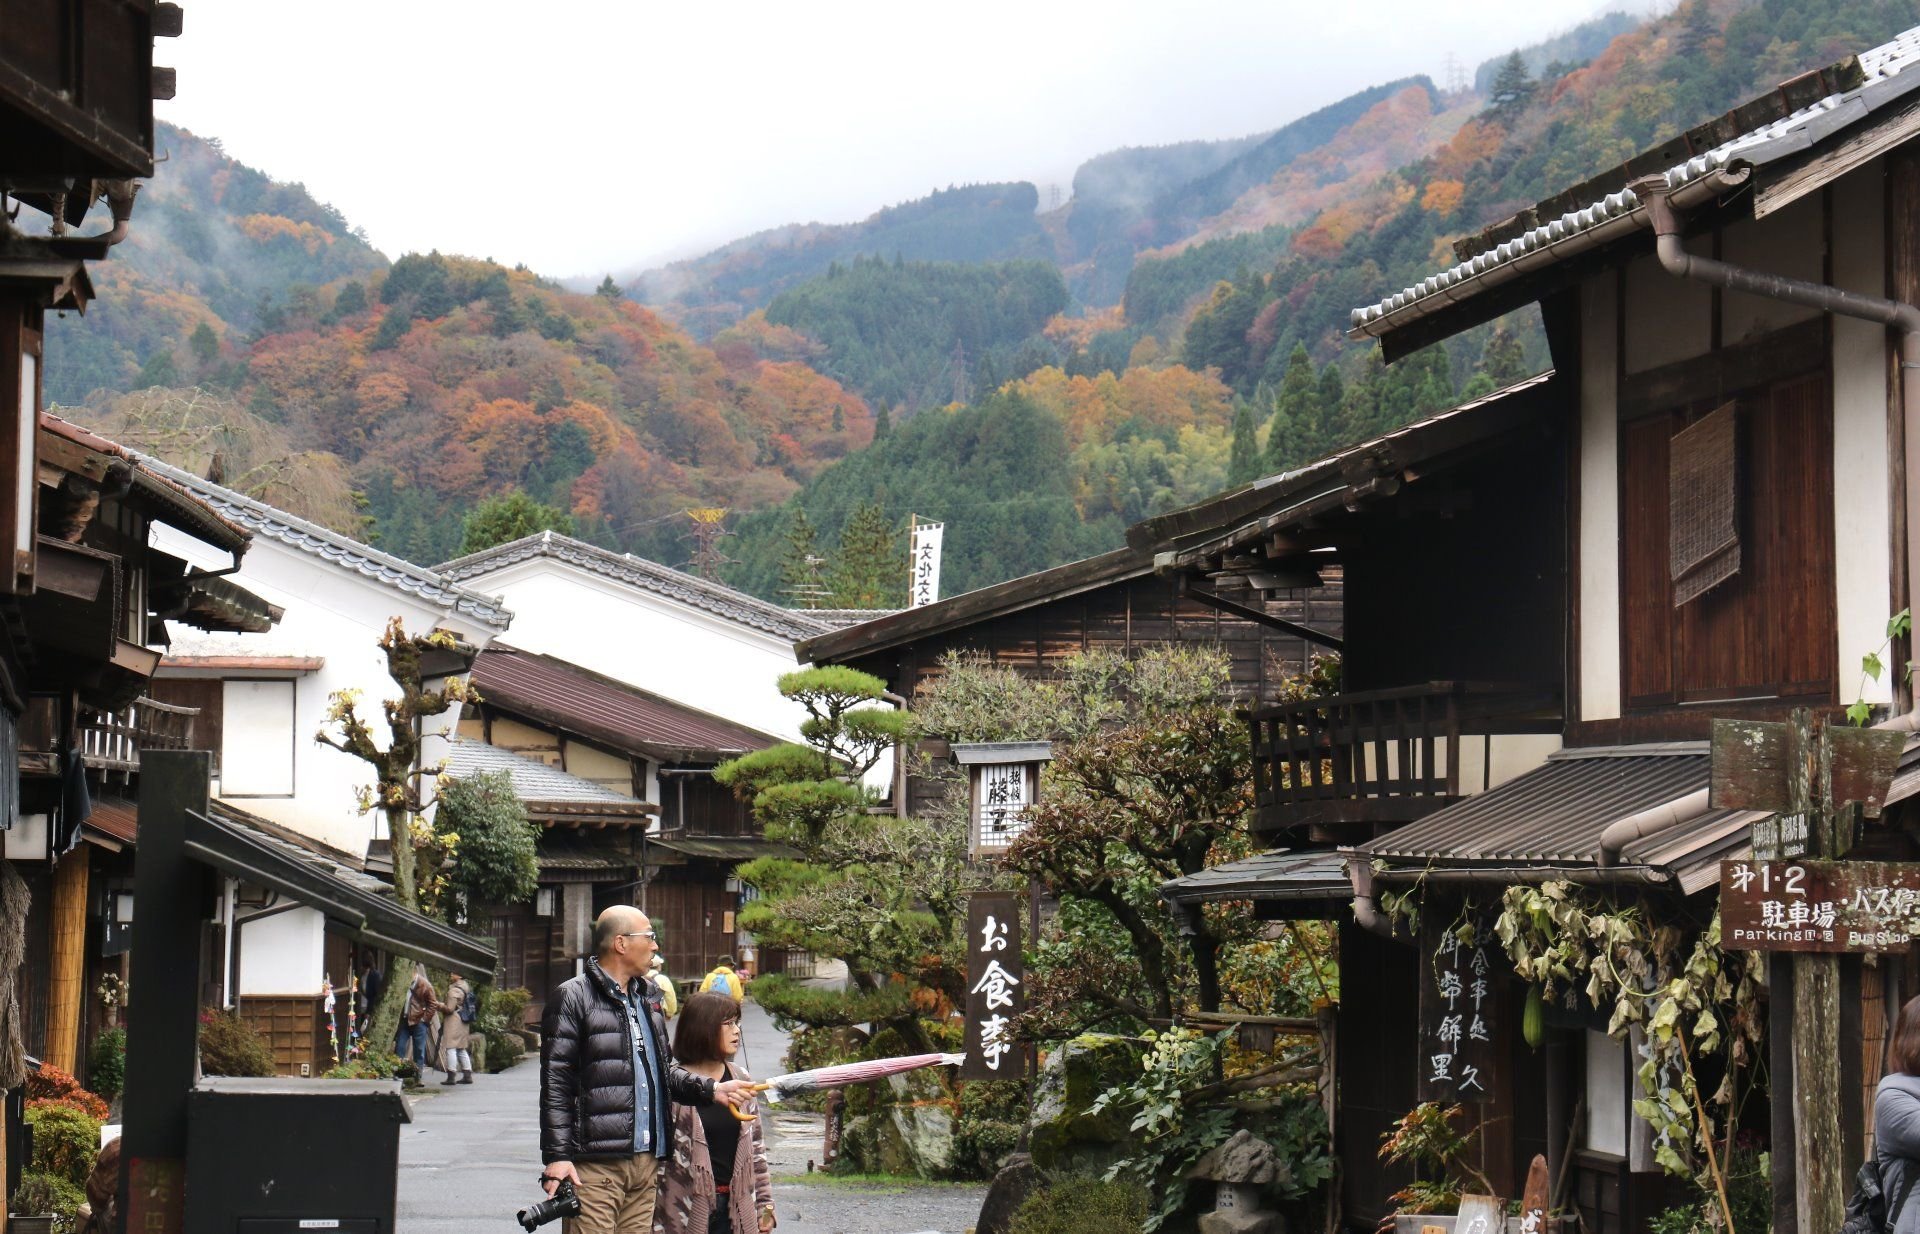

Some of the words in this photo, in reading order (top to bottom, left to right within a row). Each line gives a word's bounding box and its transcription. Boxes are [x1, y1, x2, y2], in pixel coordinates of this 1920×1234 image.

[1761, 901, 1836, 929] 駐車場
[1734, 929, 1802, 942] Parking
[971, 915, 1019, 1071] お食事
